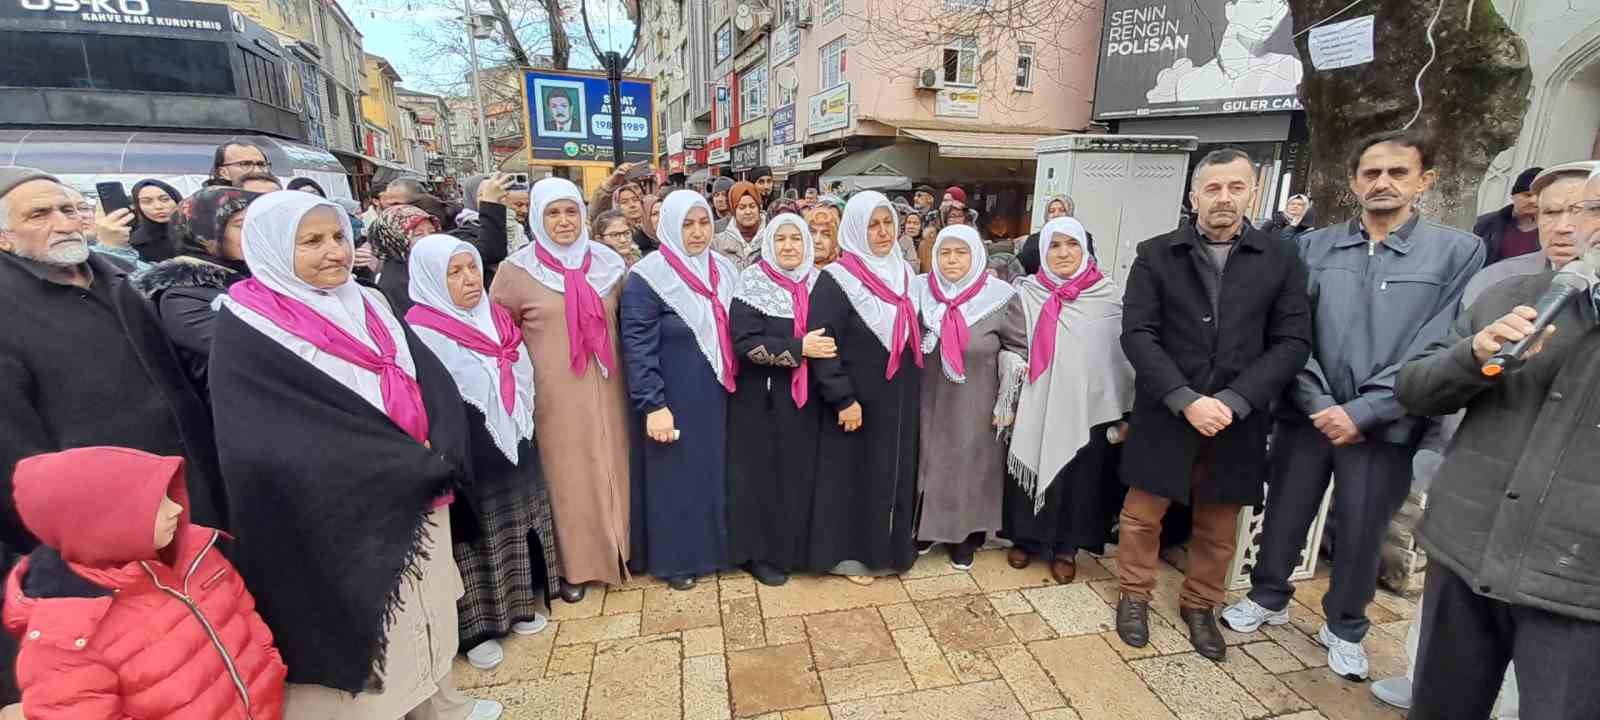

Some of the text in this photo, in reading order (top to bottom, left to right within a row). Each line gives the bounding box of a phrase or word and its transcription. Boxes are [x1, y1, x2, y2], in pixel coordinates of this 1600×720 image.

[81, 13, 122, 23] KAHVE
[124, 15, 154, 25] KAFE
[603, 94, 634, 105] SAT
